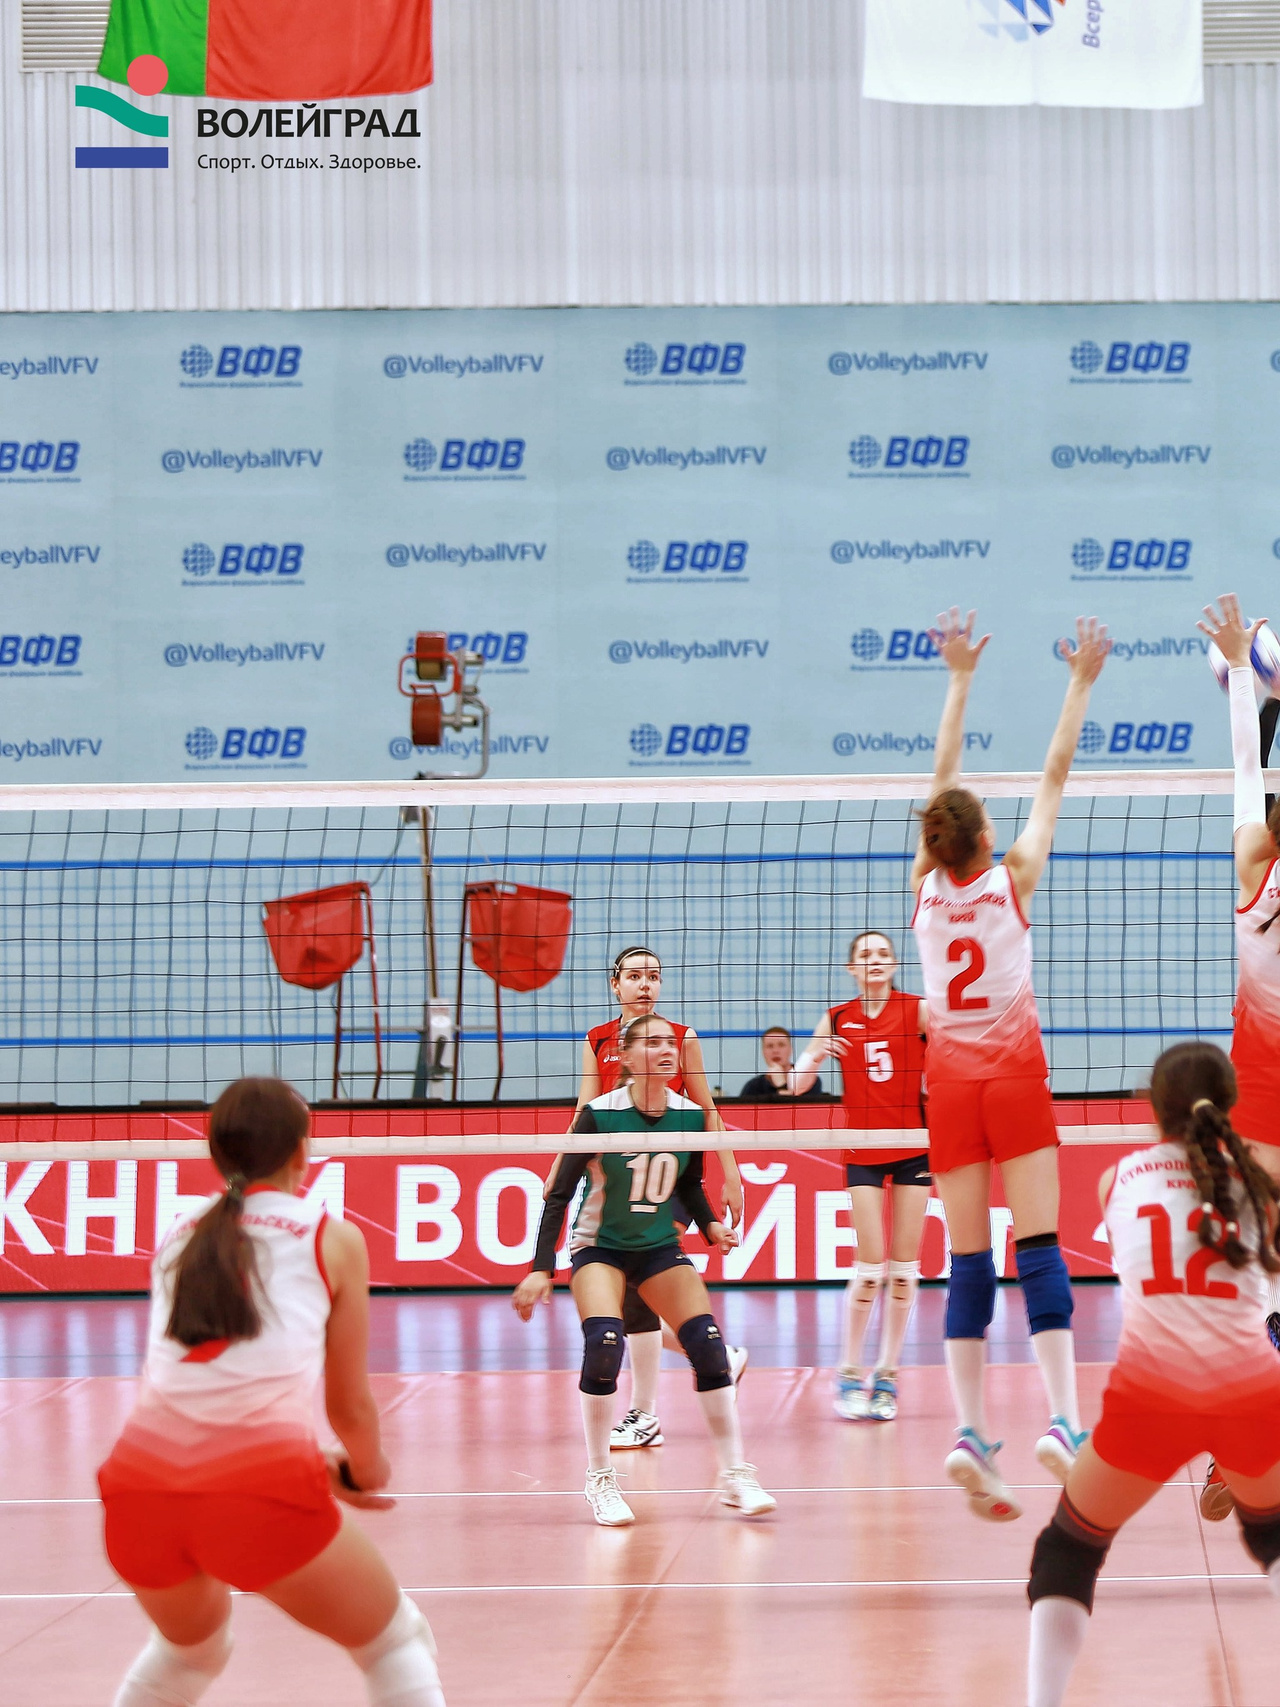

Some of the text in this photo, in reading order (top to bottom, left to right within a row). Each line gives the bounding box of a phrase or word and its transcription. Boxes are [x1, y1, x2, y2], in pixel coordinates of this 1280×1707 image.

[215, 344, 303, 378] ВФВ
[383, 354, 543, 378] @VolleyballVFV
[659, 342, 746, 375] ВФВ
[828, 352, 988, 375] @VolleyballVFV
[1105, 340, 1191, 373] ВФВ
[161, 449, 323, 473] @VolleyballVFV
[438, 437, 526, 471] ВФВ
[606, 446, 767, 471] @VolleyballVFV
[883, 434, 970, 468] ВФВ
[1051, 445, 1211, 469] @VolleyballVFV
[217, 542, 304, 576] ВФВ
[385, 543, 546, 567] @VolleyballVFV
[661, 540, 749, 573] ВФВ
[830, 540, 990, 564] @VolleyballVFV
[1106, 538, 1193, 571] ВФВ
[0, 633, 82, 667] ВФВ
[163, 642, 325, 667] @VolleyballVFV
[608, 640, 769, 664] @VolleyballVFV
[886, 628, 968, 661] ВФ
[219, 726, 308, 760] ВФВ
[664, 723, 751, 756] ВФВ
[1107, 721, 1193, 755] ВФВ
[947, 937, 988, 1011] 2
[863, 1040, 895, 1083] 5
[625, 1152, 679, 1204] 10
[1166, 1179, 1198, 1190] КРА
[1137, 1203, 1240, 1300] 12
